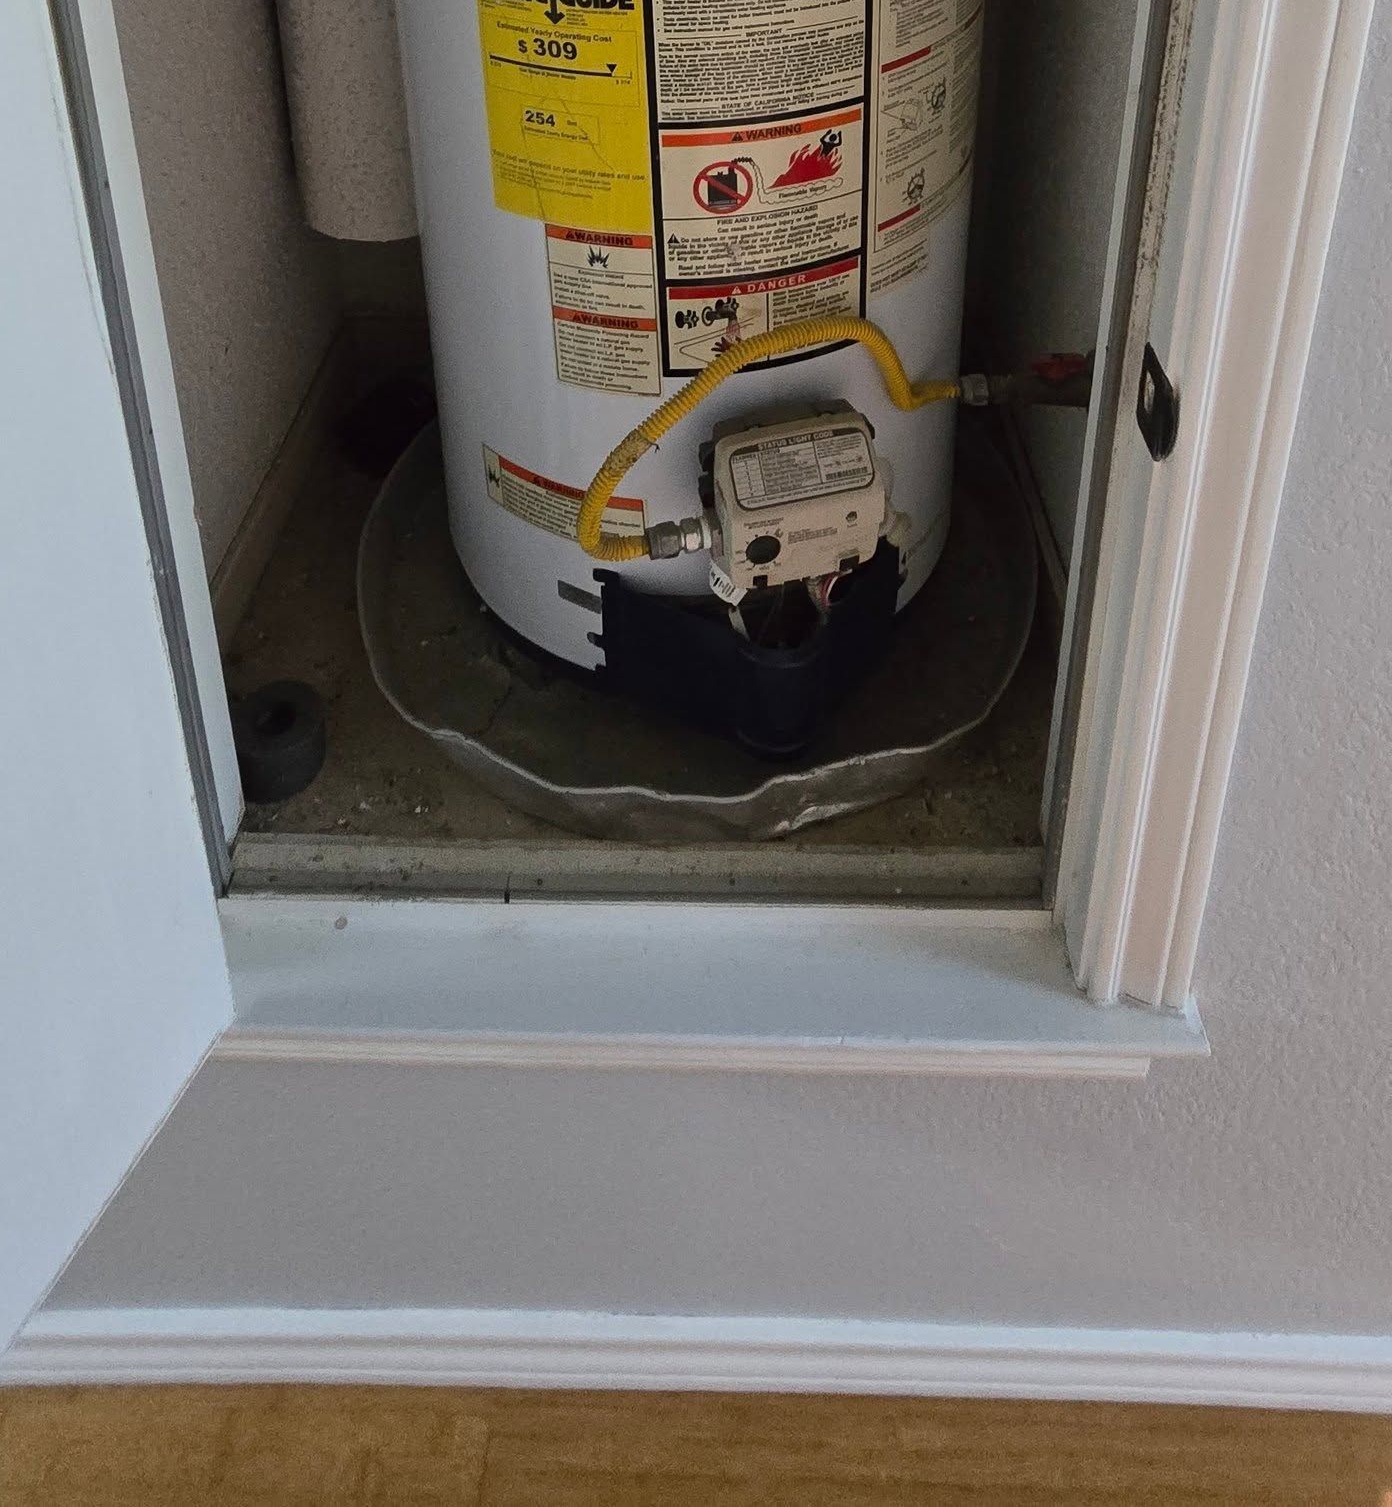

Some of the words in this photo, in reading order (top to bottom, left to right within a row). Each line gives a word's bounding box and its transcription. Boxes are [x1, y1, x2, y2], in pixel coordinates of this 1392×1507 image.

[497, 22, 529, 34] Estimated
[530, 27, 552, 38] Yearly
[554, 31, 591, 42] Operating
[593, 35, 612, 43] Cost
[746, 28, 783, 37] IMPORTANT
[518, 39, 528, 54] $
[533, 37, 577, 60] 309
[755, 95, 791, 107] CALIFORNIA
[792, 92, 814, 101] NOTICE
[526, 110, 555, 126] 254
[747, 123, 802, 140] WARNING
[751, 211, 790, 222] EXPLOSION
[791, 205, 818, 215] HAZARD
[574, 232, 633, 246] WARNING
[747, 274, 806, 293] DANGER
[580, 314, 638, 328] WARNING
